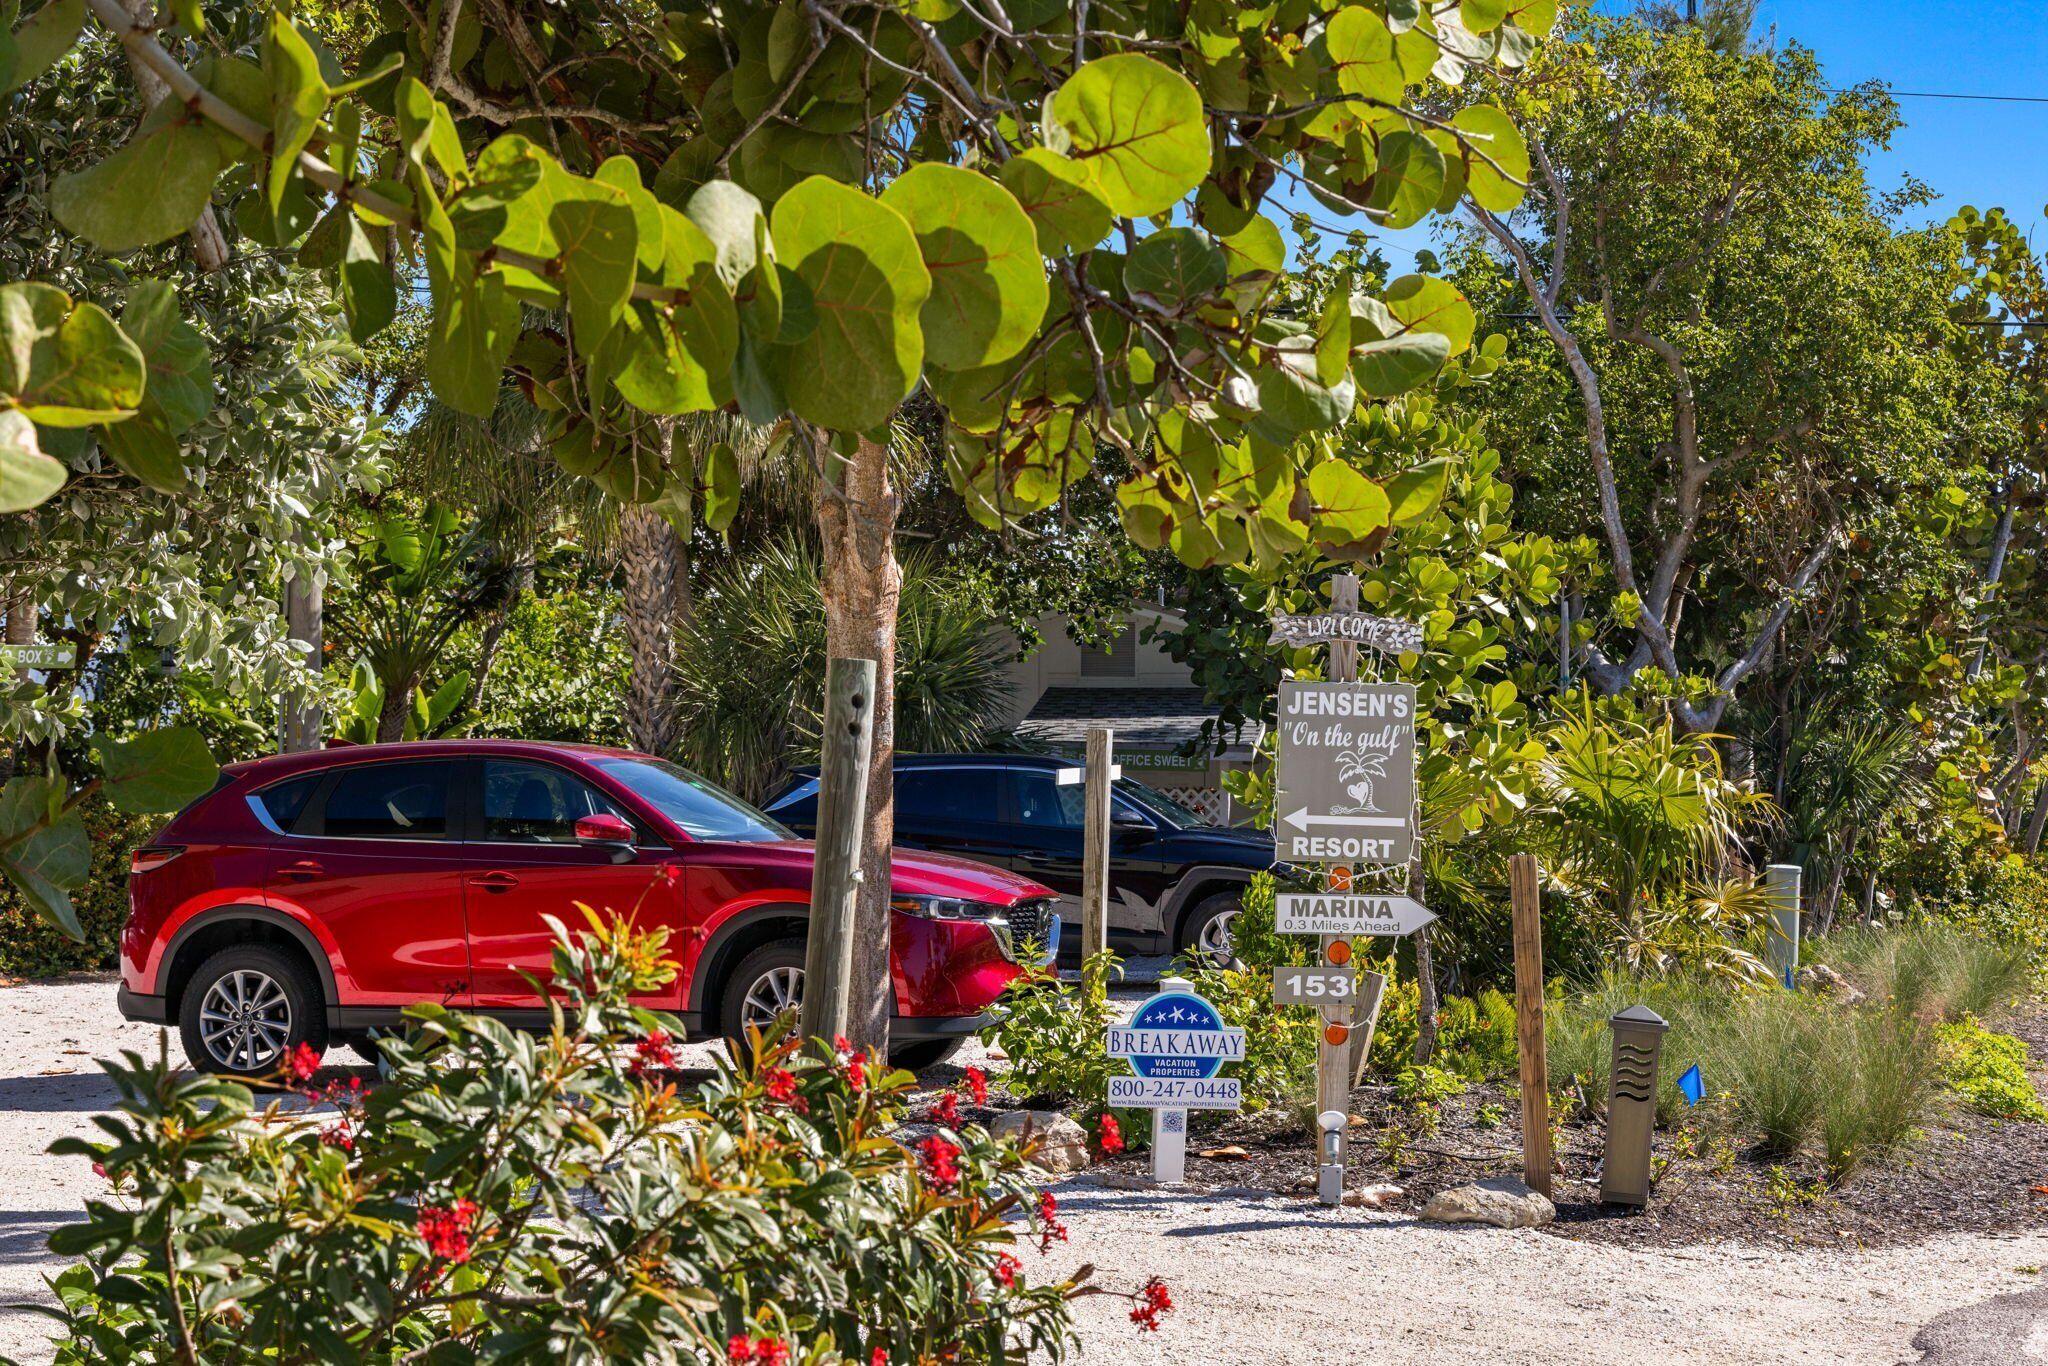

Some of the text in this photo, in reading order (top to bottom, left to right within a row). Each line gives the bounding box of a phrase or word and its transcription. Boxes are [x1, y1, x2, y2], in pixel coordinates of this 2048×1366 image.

[18, 650, 42, 664] BOX
[1287, 691, 1408, 718] JENSEN'S
[1324, 723, 1353, 747] the
[1112, 754, 1192, 768] OFFICE SWEET
[1292, 836, 1395, 859] RESORT
[1290, 898, 1393, 919] MARINA
[1284, 919, 1400, 932] 0.3 Miles Ahead
[1155, 1059, 1196, 1068] VACATION
[1150, 1068, 1200, 1077] PROPERTIES
[1111, 1080, 1238, 1099] 800-247-0448
